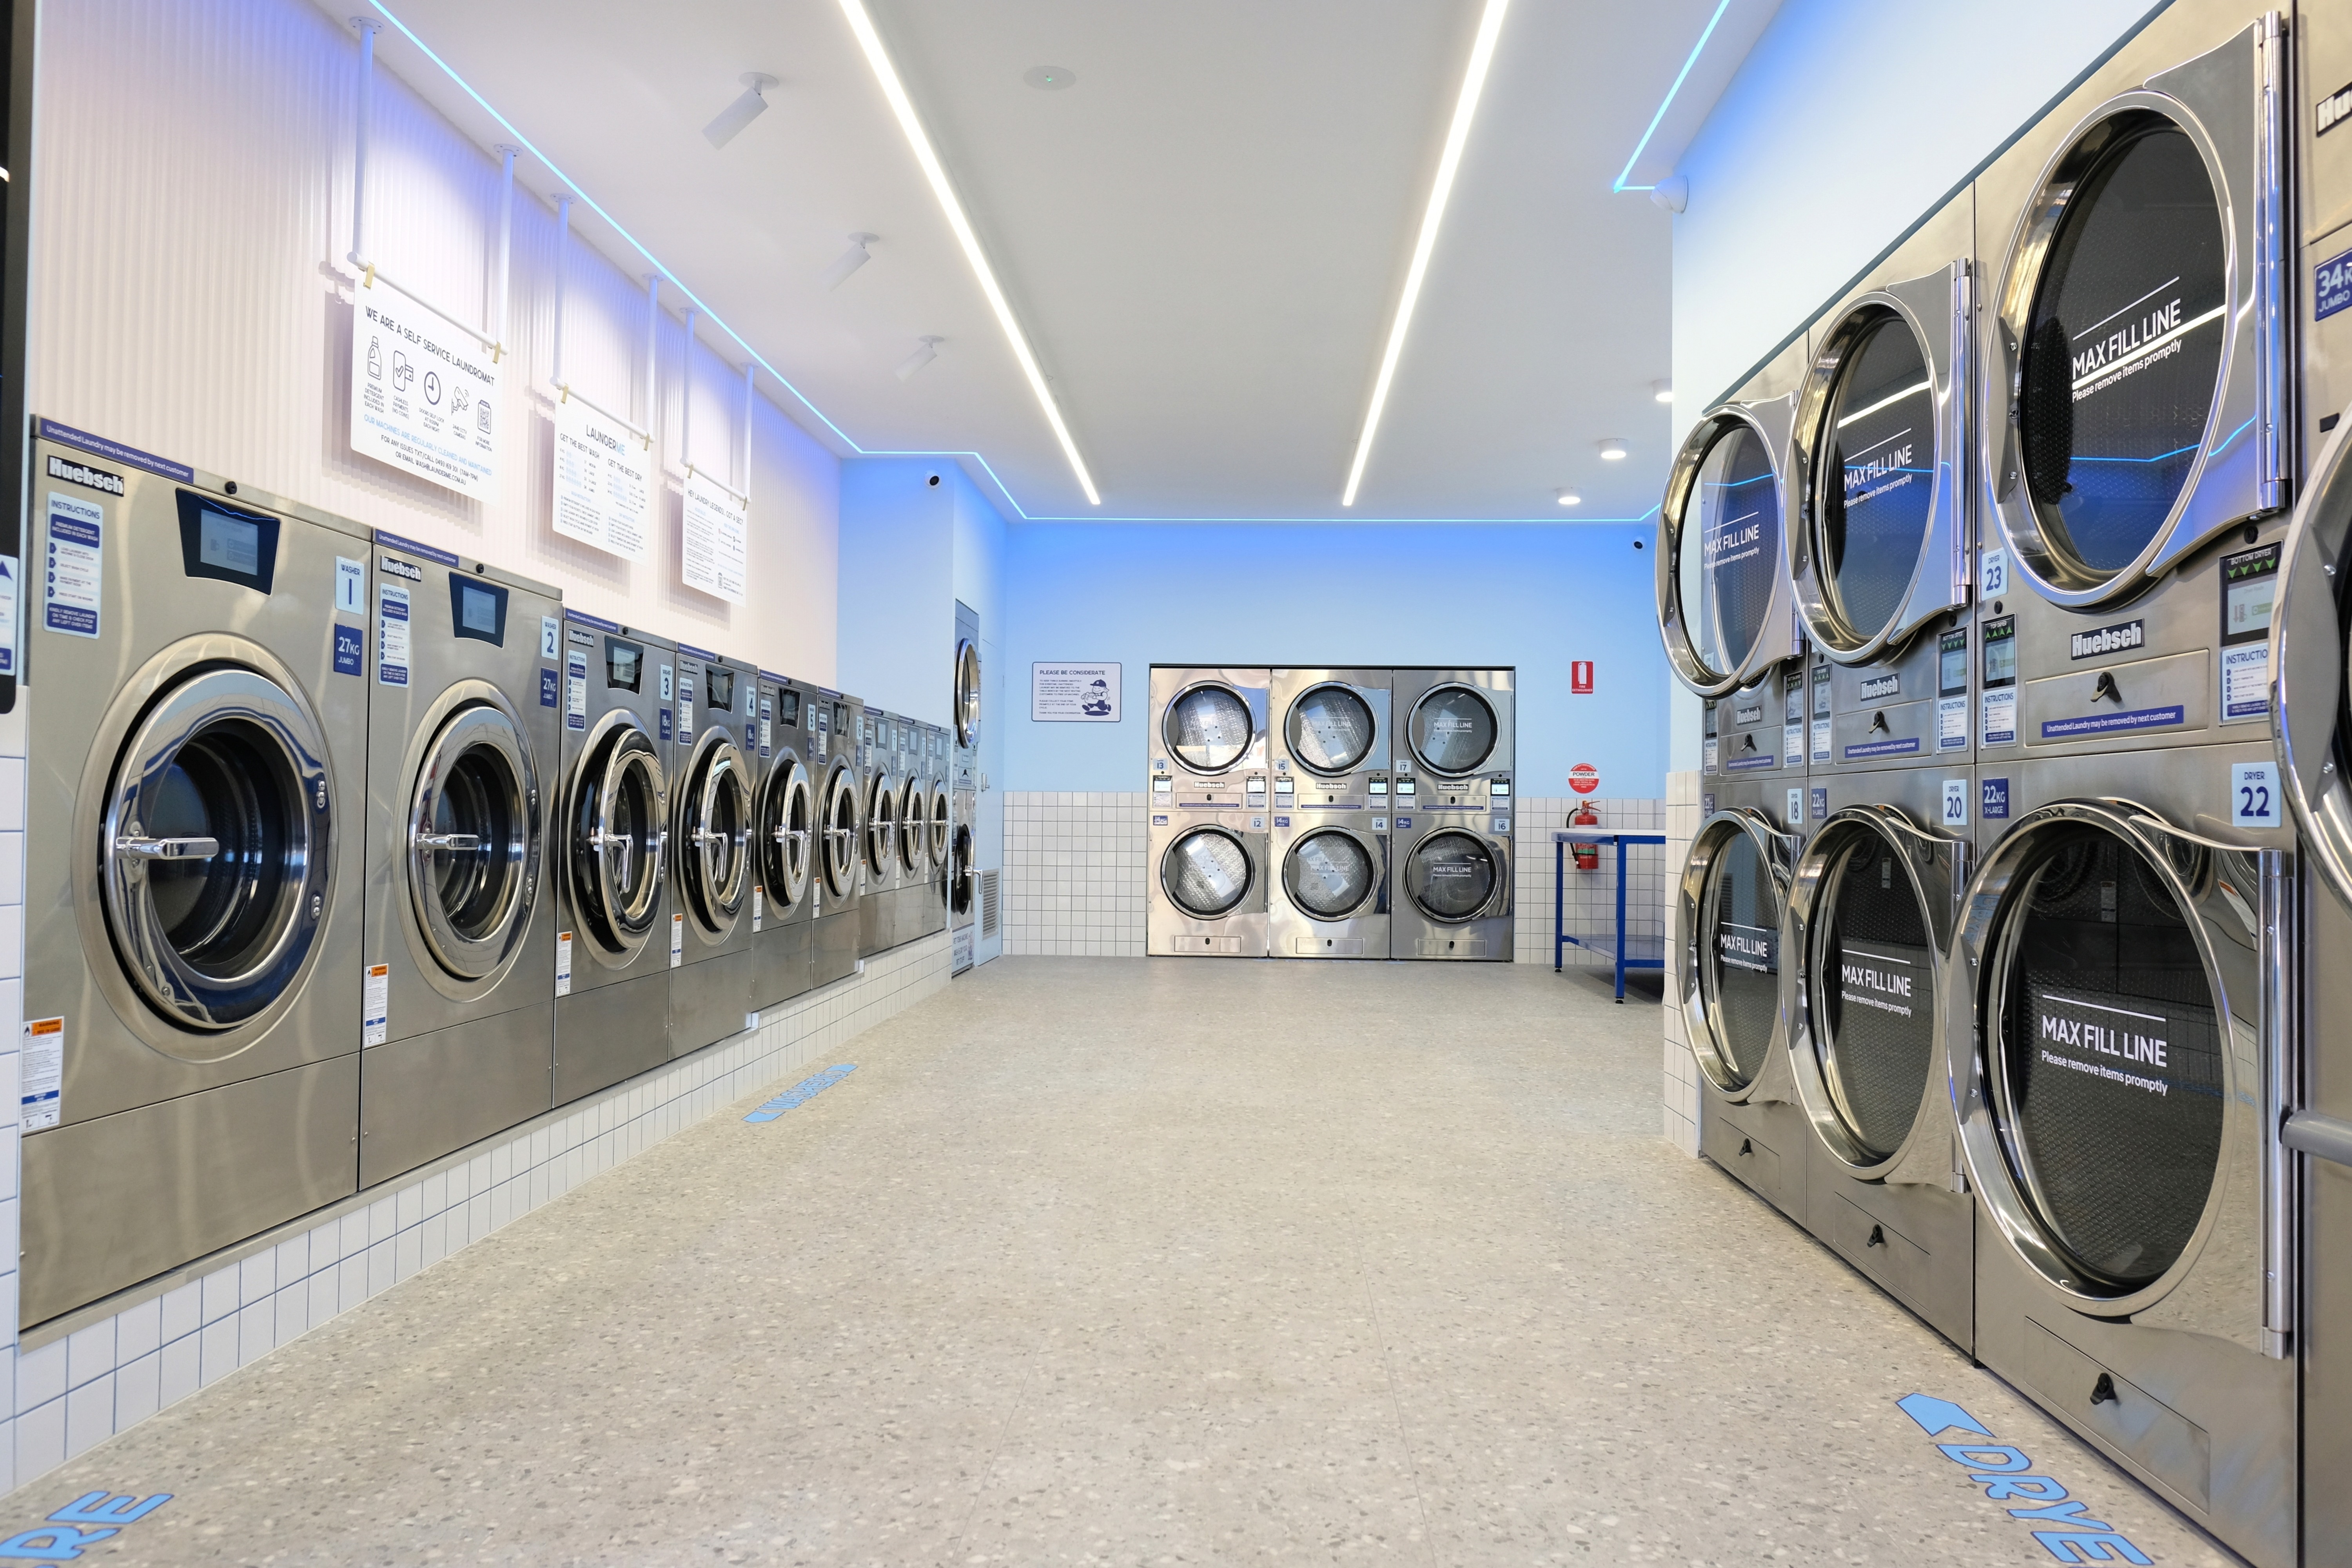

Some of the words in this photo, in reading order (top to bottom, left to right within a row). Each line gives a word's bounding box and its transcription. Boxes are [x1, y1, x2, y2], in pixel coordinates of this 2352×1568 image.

[2318, 290, 2350, 312] JUMBO
[365, 305, 377, 322] WE
[380, 315, 394, 331] ARE
[396, 324, 401, 335] A
[404, 328, 421, 344] SELF
[423, 339, 450, 362] SERVICE
[452, 355, 494, 386] LAUNDROMAT
[2073, 340, 2106, 380] MAX
[2109, 324, 2140, 361] FILL
[2143, 298, 2180, 342] LINE
[2072, 385, 2094, 403] Please
[2094, 371, 2122, 391] remove
[2122, 359, 2143, 377] items
[2144, 339, 2181, 369] promptly
[364, 414, 375, 425] OUR
[376, 419, 400, 436] MACHINES
[401, 431, 410, 440] ARE
[411, 435, 436, 451] REGULARLY
[438, 447, 457, 461] CLEANED
[459, 456, 467, 465] AND
[468, 461, 492, 475] MAINTAINED
[560, 433, 568, 442] GET
[578, 442, 587, 452] BEST
[589, 448, 599, 458] WASH
[381, 434, 390, 443] FOR
[390, 439, 399, 447] ANY
[400, 443, 413, 454] ISSUES
[414, 448, 434, 463] TXT/CALL
[435, 458, 445, 467] 0493
[460, 468, 478, 481] (7AM-7PM)
[49, 456, 123, 494] Huebsch
[402, 454, 414, 464] EMAIL
[415, 459, 466, 485] WASH@LAUNDERME.COM.AU
[608, 458, 616, 467] GET
[625, 467, 634, 477] BEST
[1844, 465, 1866, 491] MAX
[1867, 457, 1887, 481] FILL
[1889, 444, 1912, 472] LINE
[695, 494, 709, 505] LAUNDRY
[1844, 497, 1858, 508] Please
[1858, 490, 1876, 502] remove
[1876, 484, 1889, 495] items
[1889, 474, 1912, 492] promptly
[51, 500, 100, 519] INSTRUCTIONS
[52, 526, 71, 534] INCLUDED
[73, 526, 94, 534] DETERGENT
[1988, 554, 2000, 564] DRYER
[2230, 553, 2254, 565] BOTTOM
[2254, 549, 2272, 559] DRYER
[341, 564, 360, 575] WASHER
[381, 556, 421, 580] Huebsch
[1986, 566, 2002, 591] 23
[382, 589, 408, 599] INSTRUCTIONS
[545, 621, 556, 630] WASHER
[338, 637, 359, 655] 27KG
[547, 631, 554, 653] 2
[569, 630, 593, 646] Huebsch
[2072, 622, 2142, 658] Huebsch
[338, 657, 354, 665] JUMBO
[543, 677, 556, 691] 27KG
[664, 677, 669, 695] 3
[1861, 676, 1898, 699] Huebsch
[750, 697, 753, 713] 4
[1940, 701, 1965, 710] INSTRUCTIONS
[1985, 692, 2014, 703] INSTRUCTIONS
[662, 715, 670, 727] 18KG
[810, 714, 813, 728] 5
[2047, 722, 2072, 732] Unattended
[2072, 720, 2090, 730] Laundry
[2108, 715, 2130, 725] removed
[2130, 715, 2137, 724] by
[2149, 712, 2176, 721] customer
[2244, 771, 2265, 780] DRYER
[1813, 794, 1824, 807] 22KG
[1984, 786, 2005, 804] 22KG
[2241, 786, 2270, 816] 22
[1791, 801, 1798, 820] 18
[1947, 797, 1962, 818] 20
[1842, 964, 1864, 986] MAX
[1866, 969, 1886, 991] FILL
[1887, 973, 1911, 997] LINE
[2042, 1015, 2081, 1047] MAX
[2084, 1024, 2120, 1056] FILL
[2124, 1033, 2167, 1067] LINE
[2042, 1050, 2067, 1067] Please
[2068, 1059, 2099, 1075] remove
[2100, 1064, 2124, 1082] items
[2125, 1074, 2168, 1095] promptly
